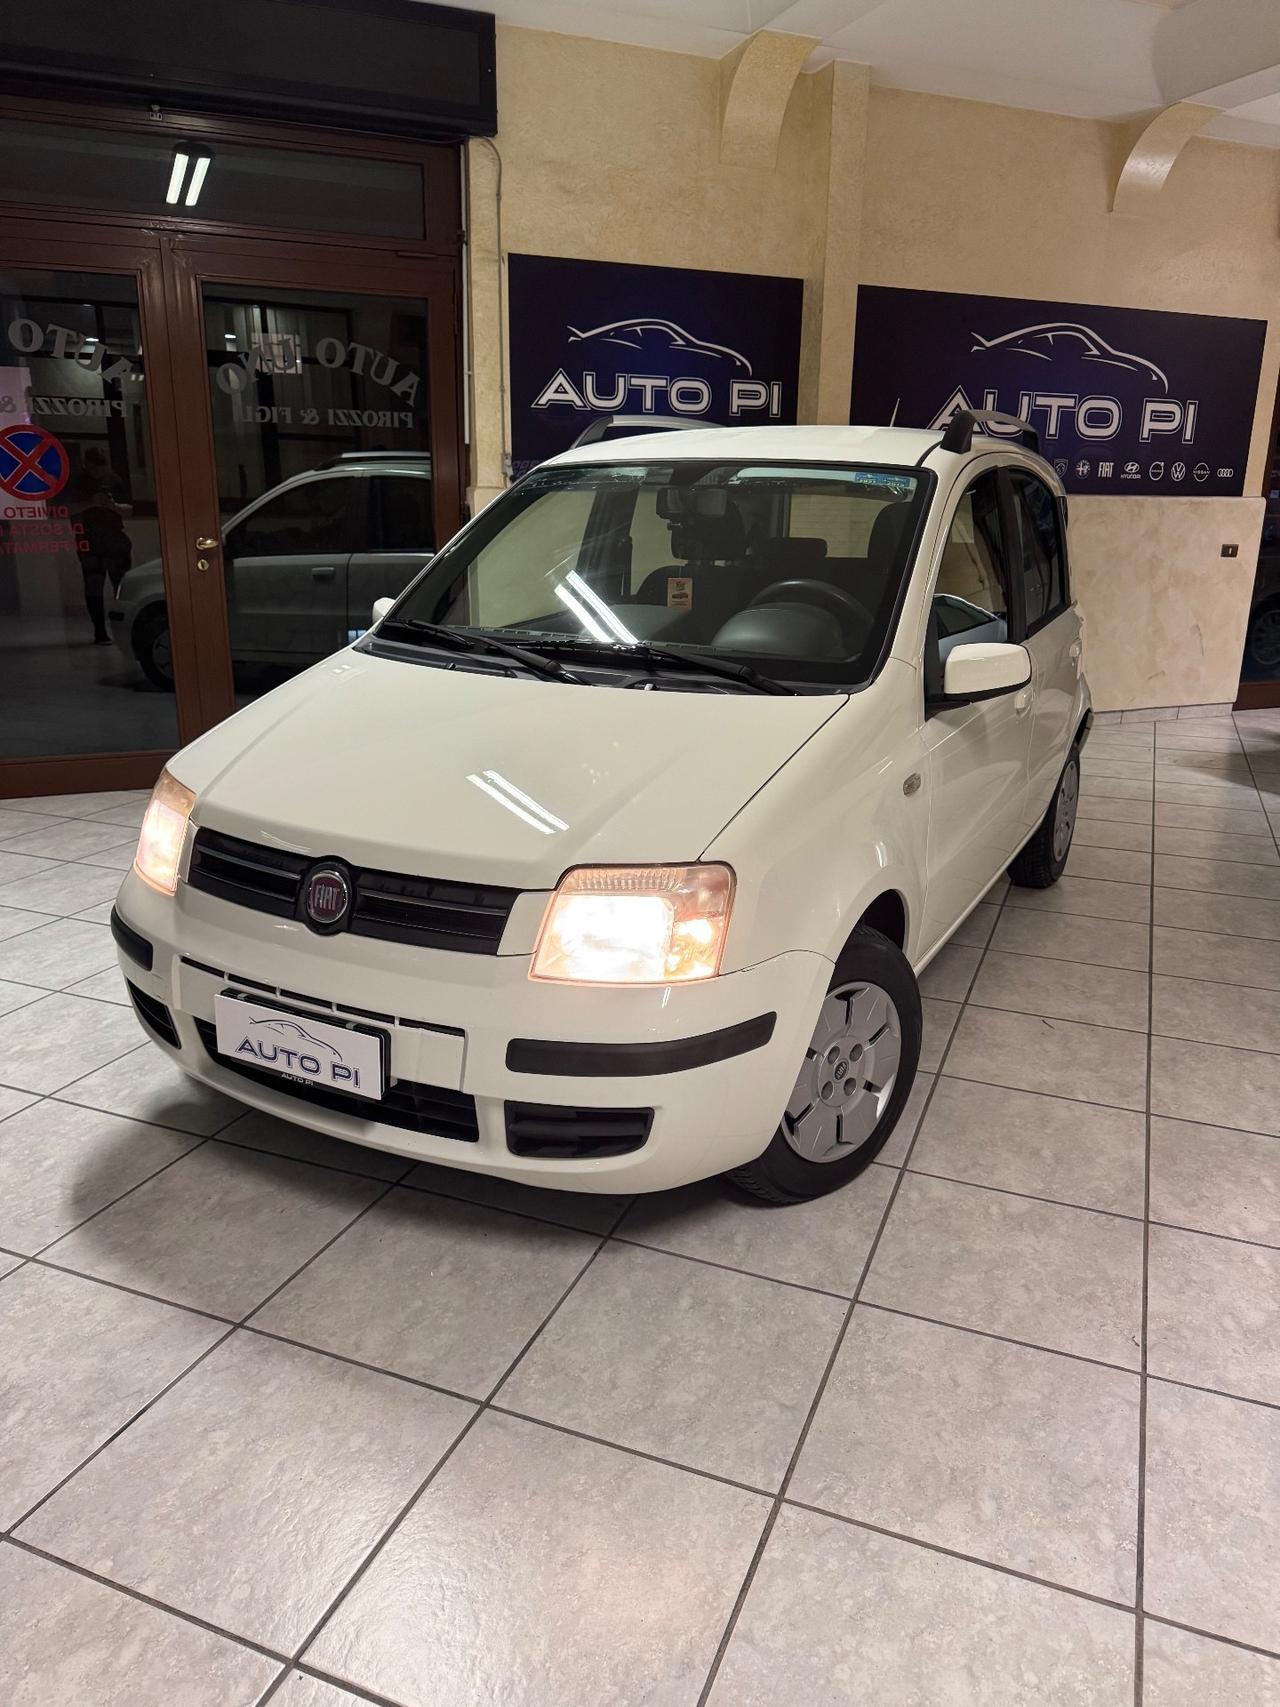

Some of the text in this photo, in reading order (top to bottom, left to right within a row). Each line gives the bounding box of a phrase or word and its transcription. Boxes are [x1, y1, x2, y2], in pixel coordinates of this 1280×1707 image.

[531, 368, 782, 418] AUTO PI
[927, 384, 1198, 444] AUTO PI
[1097, 461, 1115, 478] FIAT
[314, 883, 340, 911] FIAT
[235, 1035, 361, 1088] AUTO PI
[281, 1072, 304, 1083] AUTO
